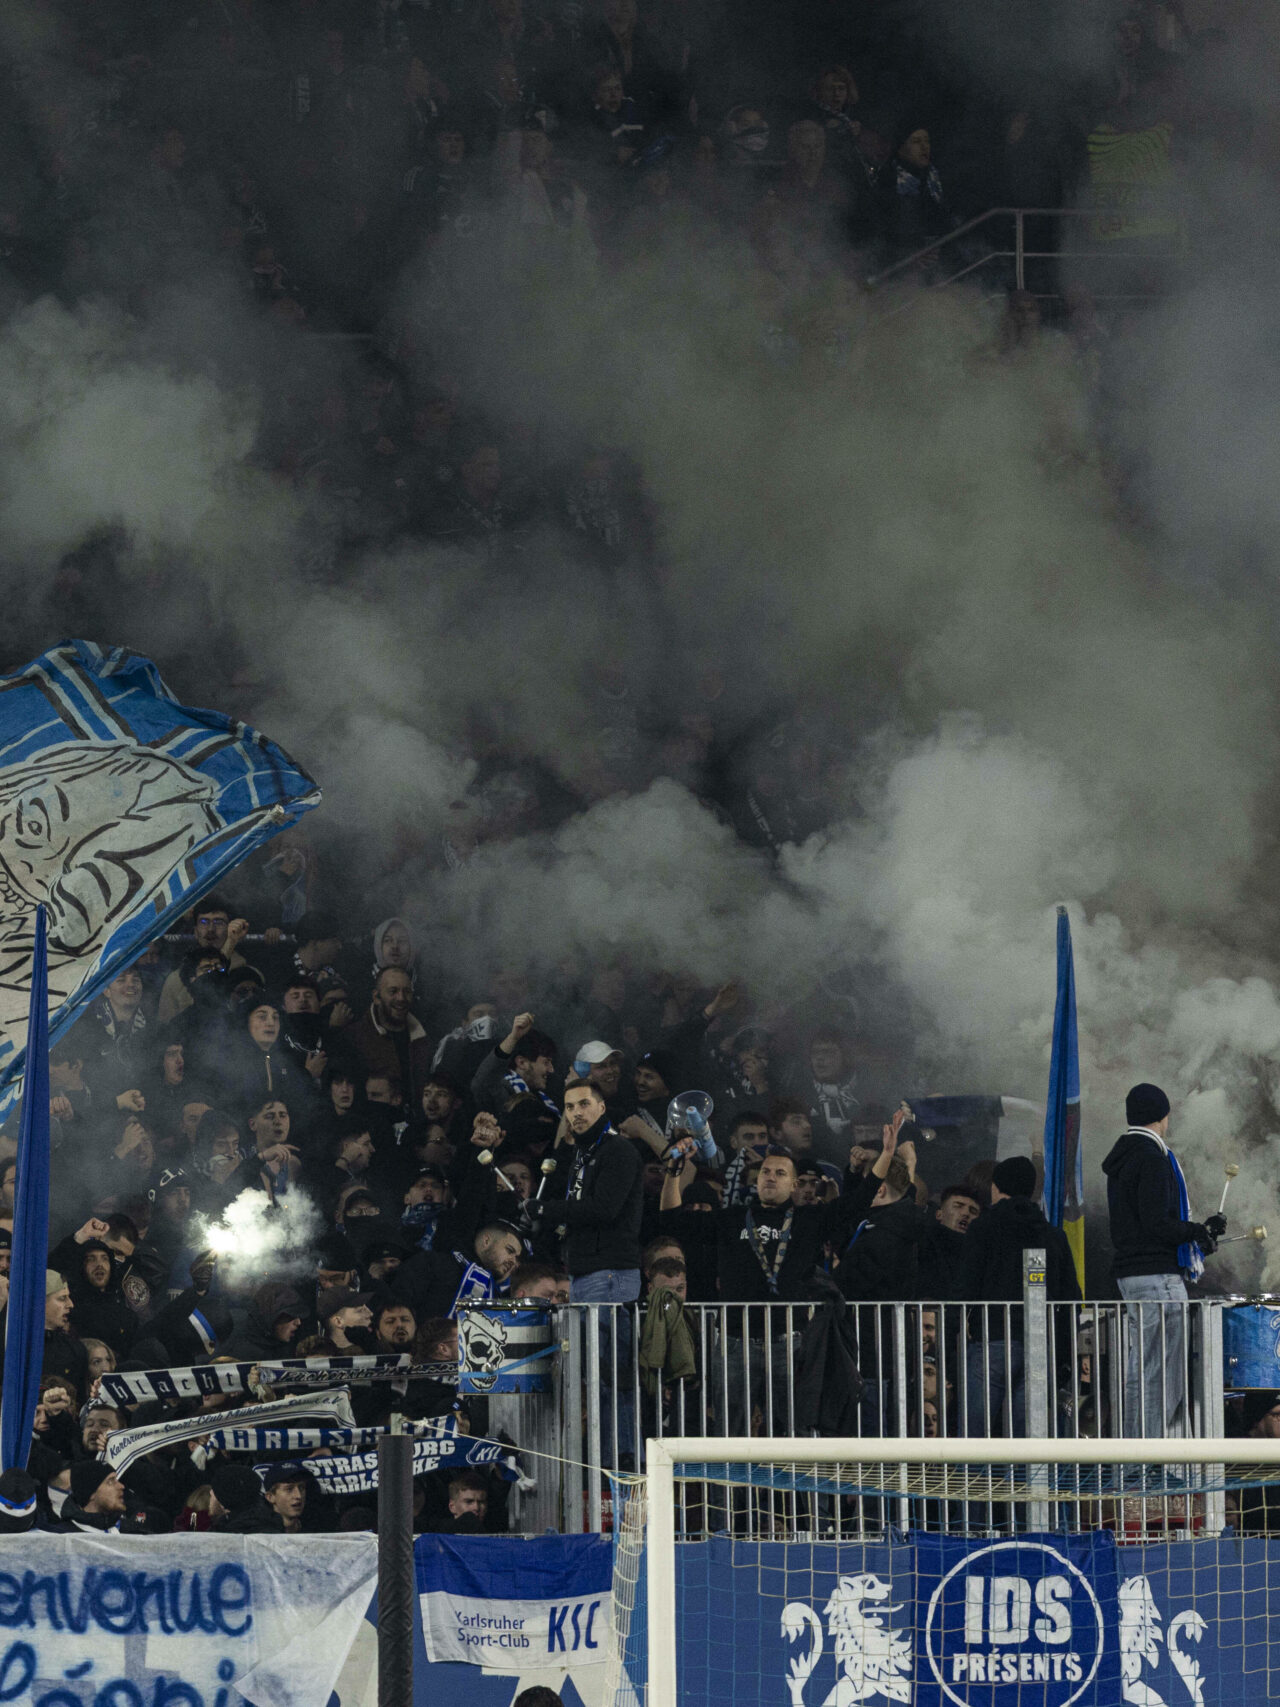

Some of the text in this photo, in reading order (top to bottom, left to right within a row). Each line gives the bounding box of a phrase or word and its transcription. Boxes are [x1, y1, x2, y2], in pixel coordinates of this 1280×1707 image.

[301, 1440, 456, 1476] STRASRG
[317, 1457, 441, 1495] KARLSHE
[548, 1601, 601, 1653] KSC
[965, 1575, 1072, 1644] IDS
[952, 1648, 1083, 1683] PRÉSENTS
